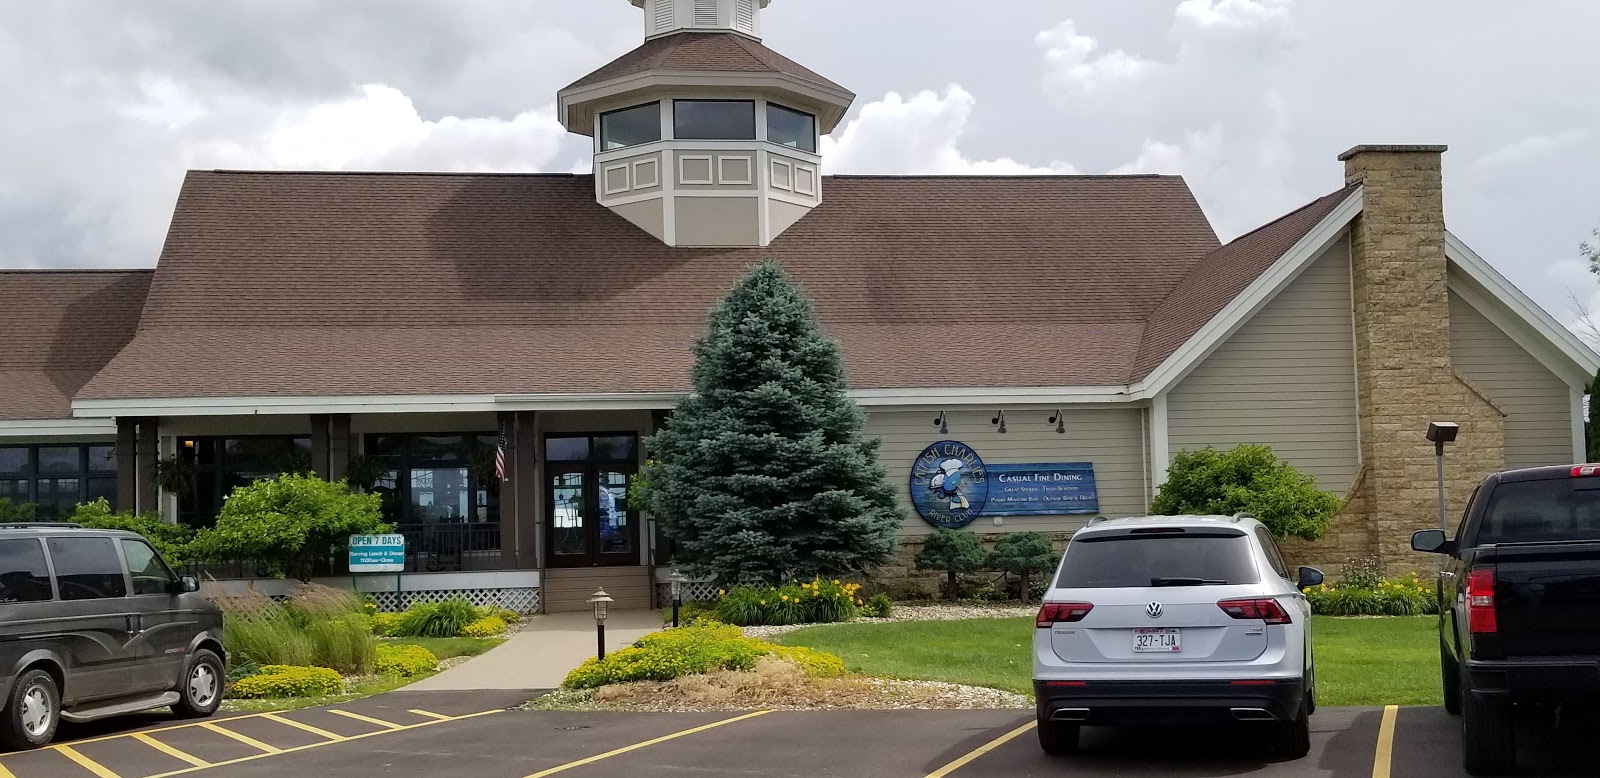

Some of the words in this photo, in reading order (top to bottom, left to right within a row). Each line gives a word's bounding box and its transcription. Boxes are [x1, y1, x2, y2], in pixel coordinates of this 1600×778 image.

[914, 447, 941, 486] CATFISH
[944, 444, 985, 484] CHARLIE'S
[998, 473, 1031, 483] CASUAL
[1034, 473, 1050, 482] FINE
[1053, 472, 1083, 481] DINING
[928, 509, 951, 524] RIVER
[954, 508, 973, 523] CLUB
[352, 536, 372, 545] OPEN
[374, 536, 380, 545] 7
[382, 536, 402, 545] DAYS
[1136, 634, 1176, 647] 327-TJA
